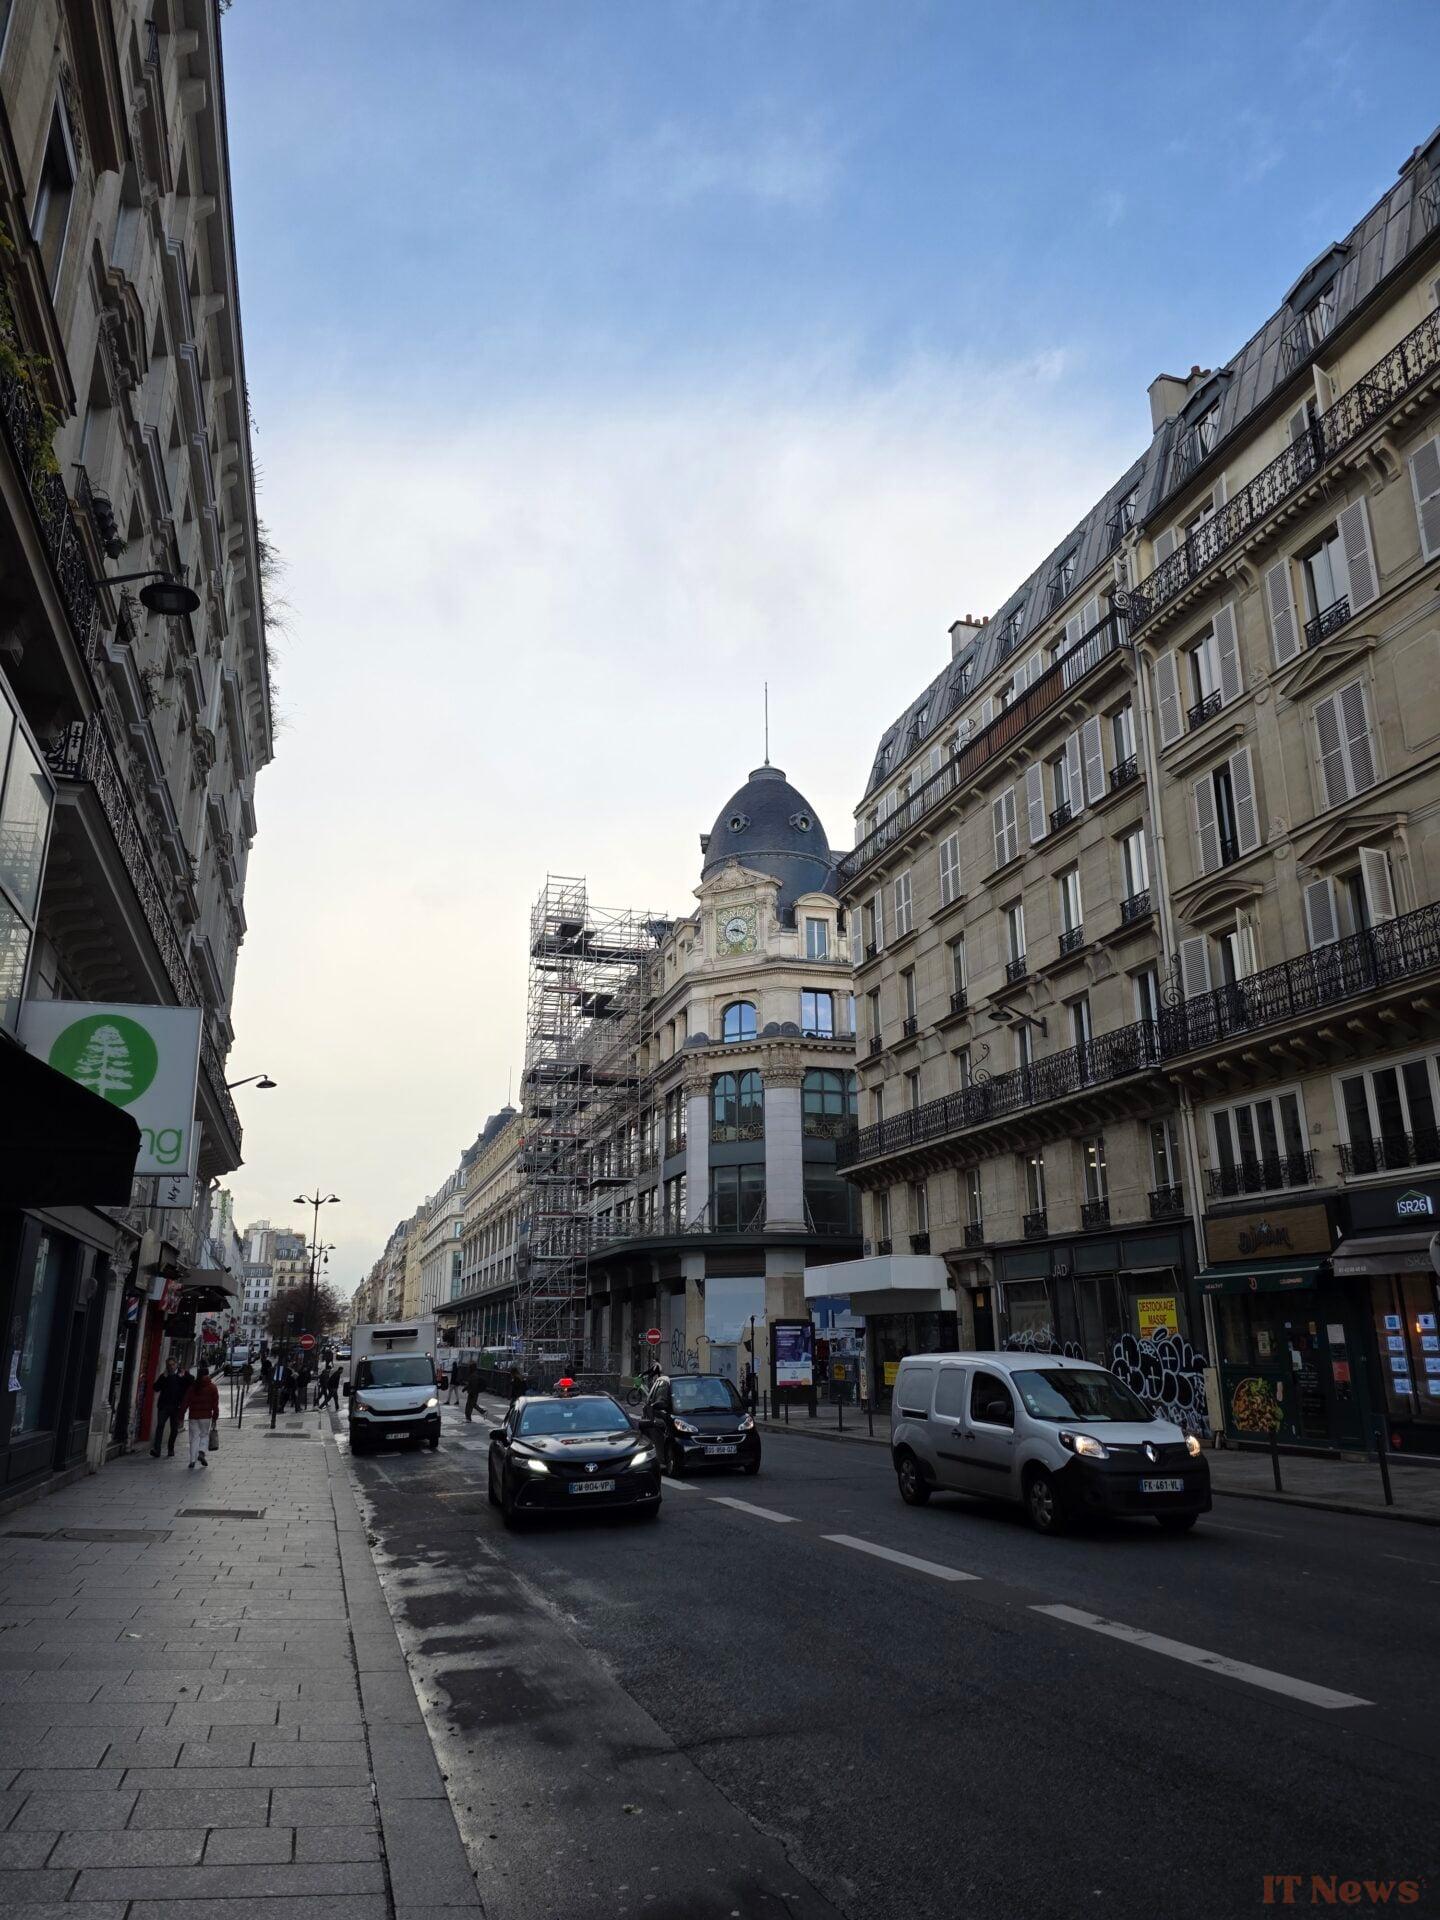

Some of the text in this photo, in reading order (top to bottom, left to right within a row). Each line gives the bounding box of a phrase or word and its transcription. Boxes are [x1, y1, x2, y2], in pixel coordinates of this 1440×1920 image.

[1396, 1198, 1427, 1214] ISR26
[1138, 1301, 1175, 1312] DESTOCKAGE
[1148, 1314, 1167, 1325] MASSIF
